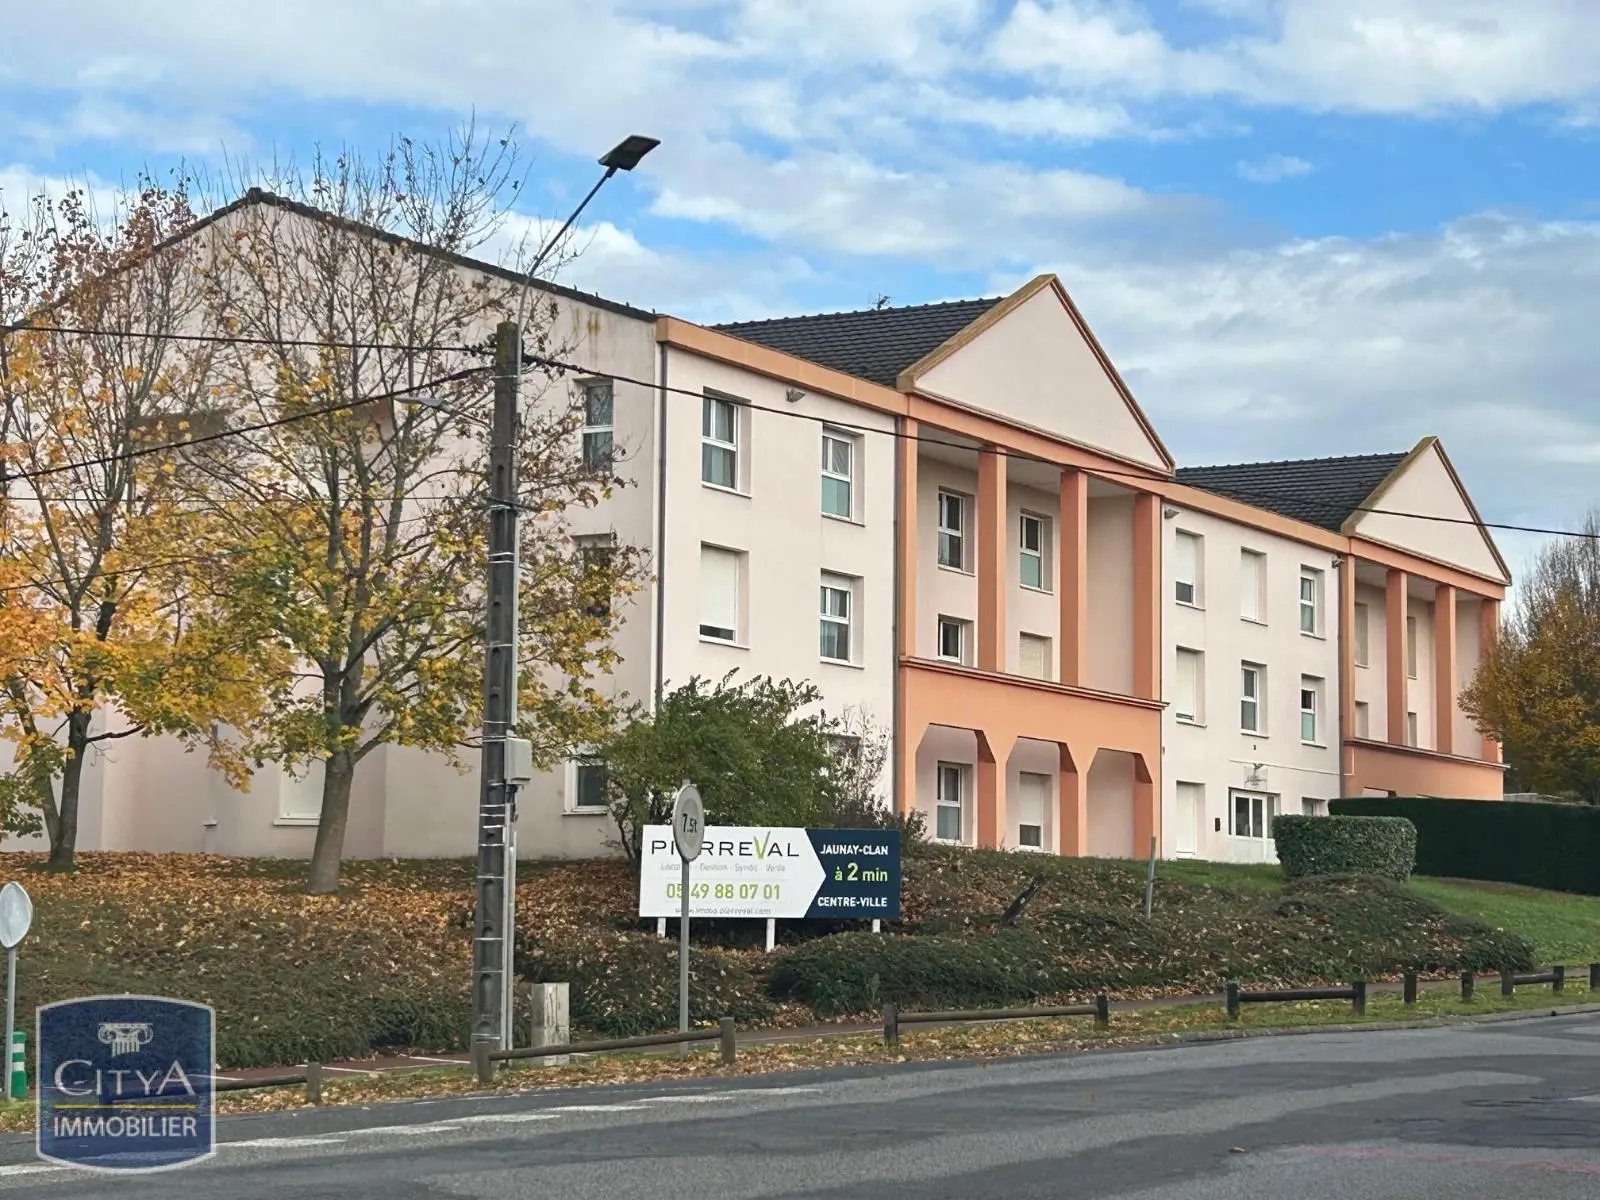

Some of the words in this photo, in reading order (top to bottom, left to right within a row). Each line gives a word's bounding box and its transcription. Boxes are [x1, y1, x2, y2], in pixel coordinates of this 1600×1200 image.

[652, 831, 799, 859] PIRREVAL
[820, 844, 888, 855] JAUNAY-CLAN
[835, 866, 843, 881] à
[847, 862, 858, 881] 2
[862, 868, 888, 881] min
[691, 884, 709, 899] 49
[715, 884, 734, 899] 88
[740, 884, 758, 899] 07
[764, 884, 780, 900] 01
[818, 896, 888, 907] CENTRE-VILLE
